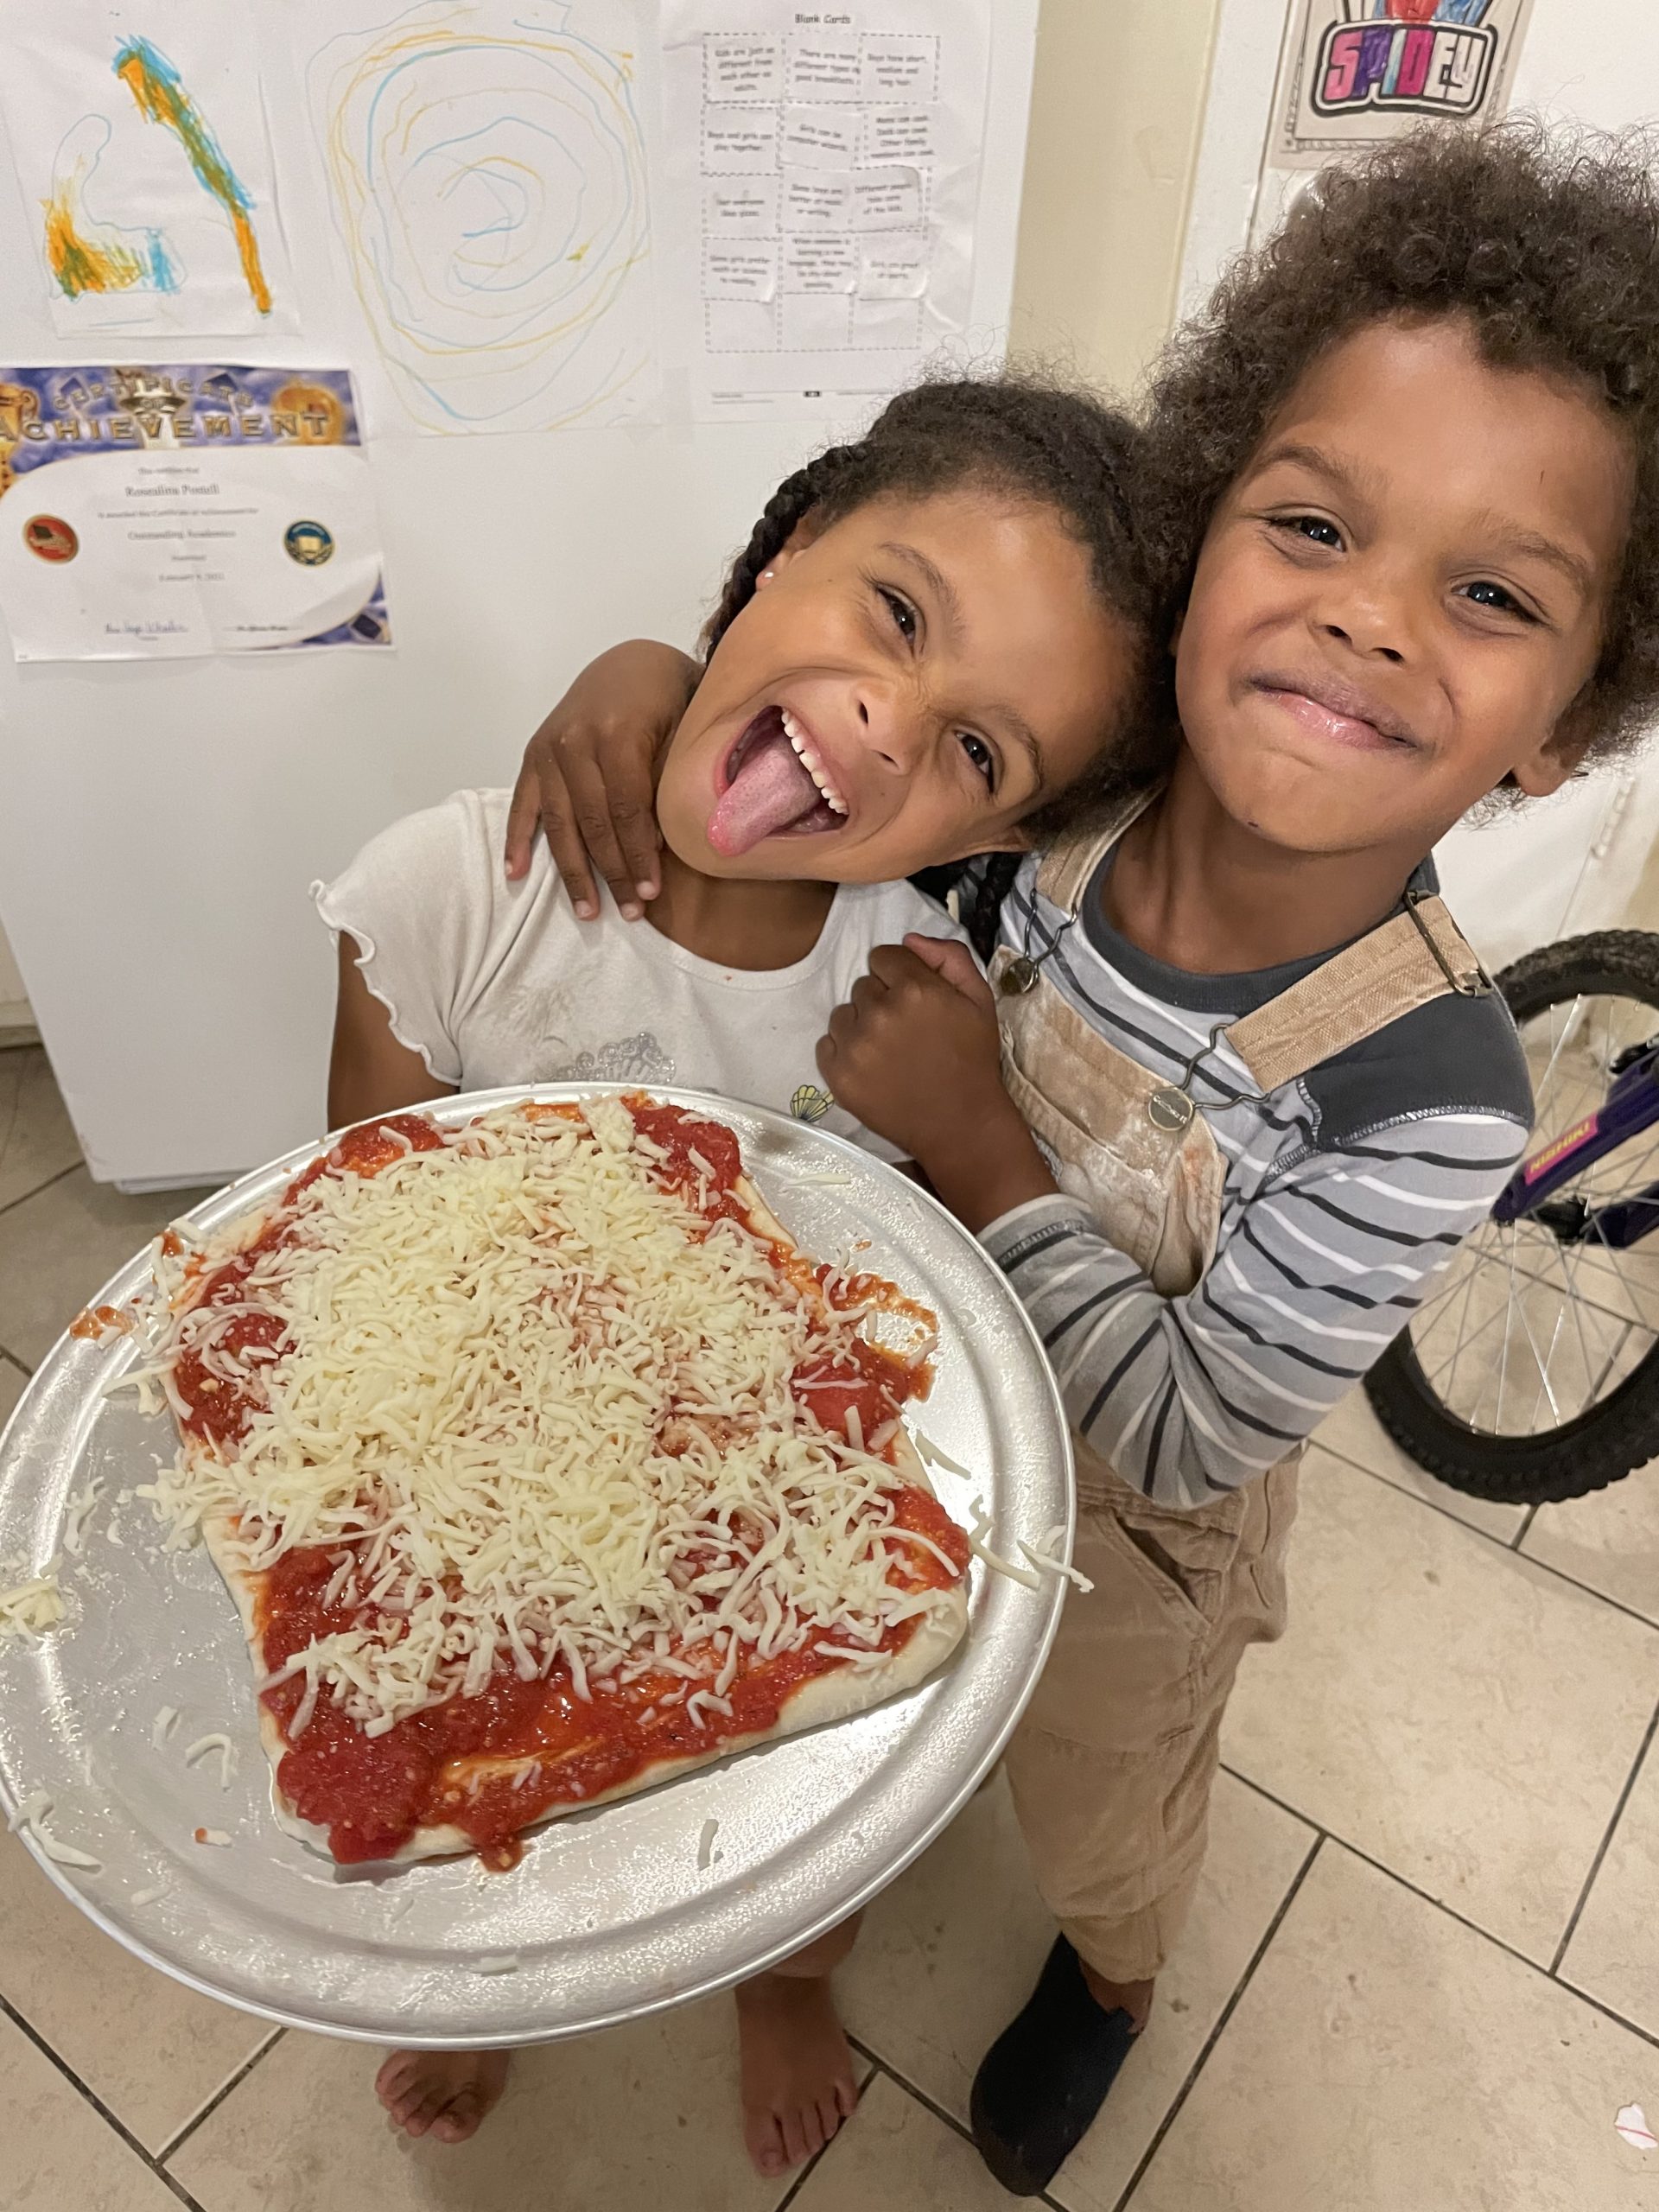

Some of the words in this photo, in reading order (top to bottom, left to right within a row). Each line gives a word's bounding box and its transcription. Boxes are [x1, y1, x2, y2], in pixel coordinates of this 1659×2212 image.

[795, 14, 821, 24] Blank
[823, 14, 851, 24] Cards
[1324, 25, 1486, 104] SPIDEY
[54, 377, 255, 410] CERTIFICATE
[141, 397, 163, 410] OF
[1529, 1120, 1590, 1175] NISHIKI
